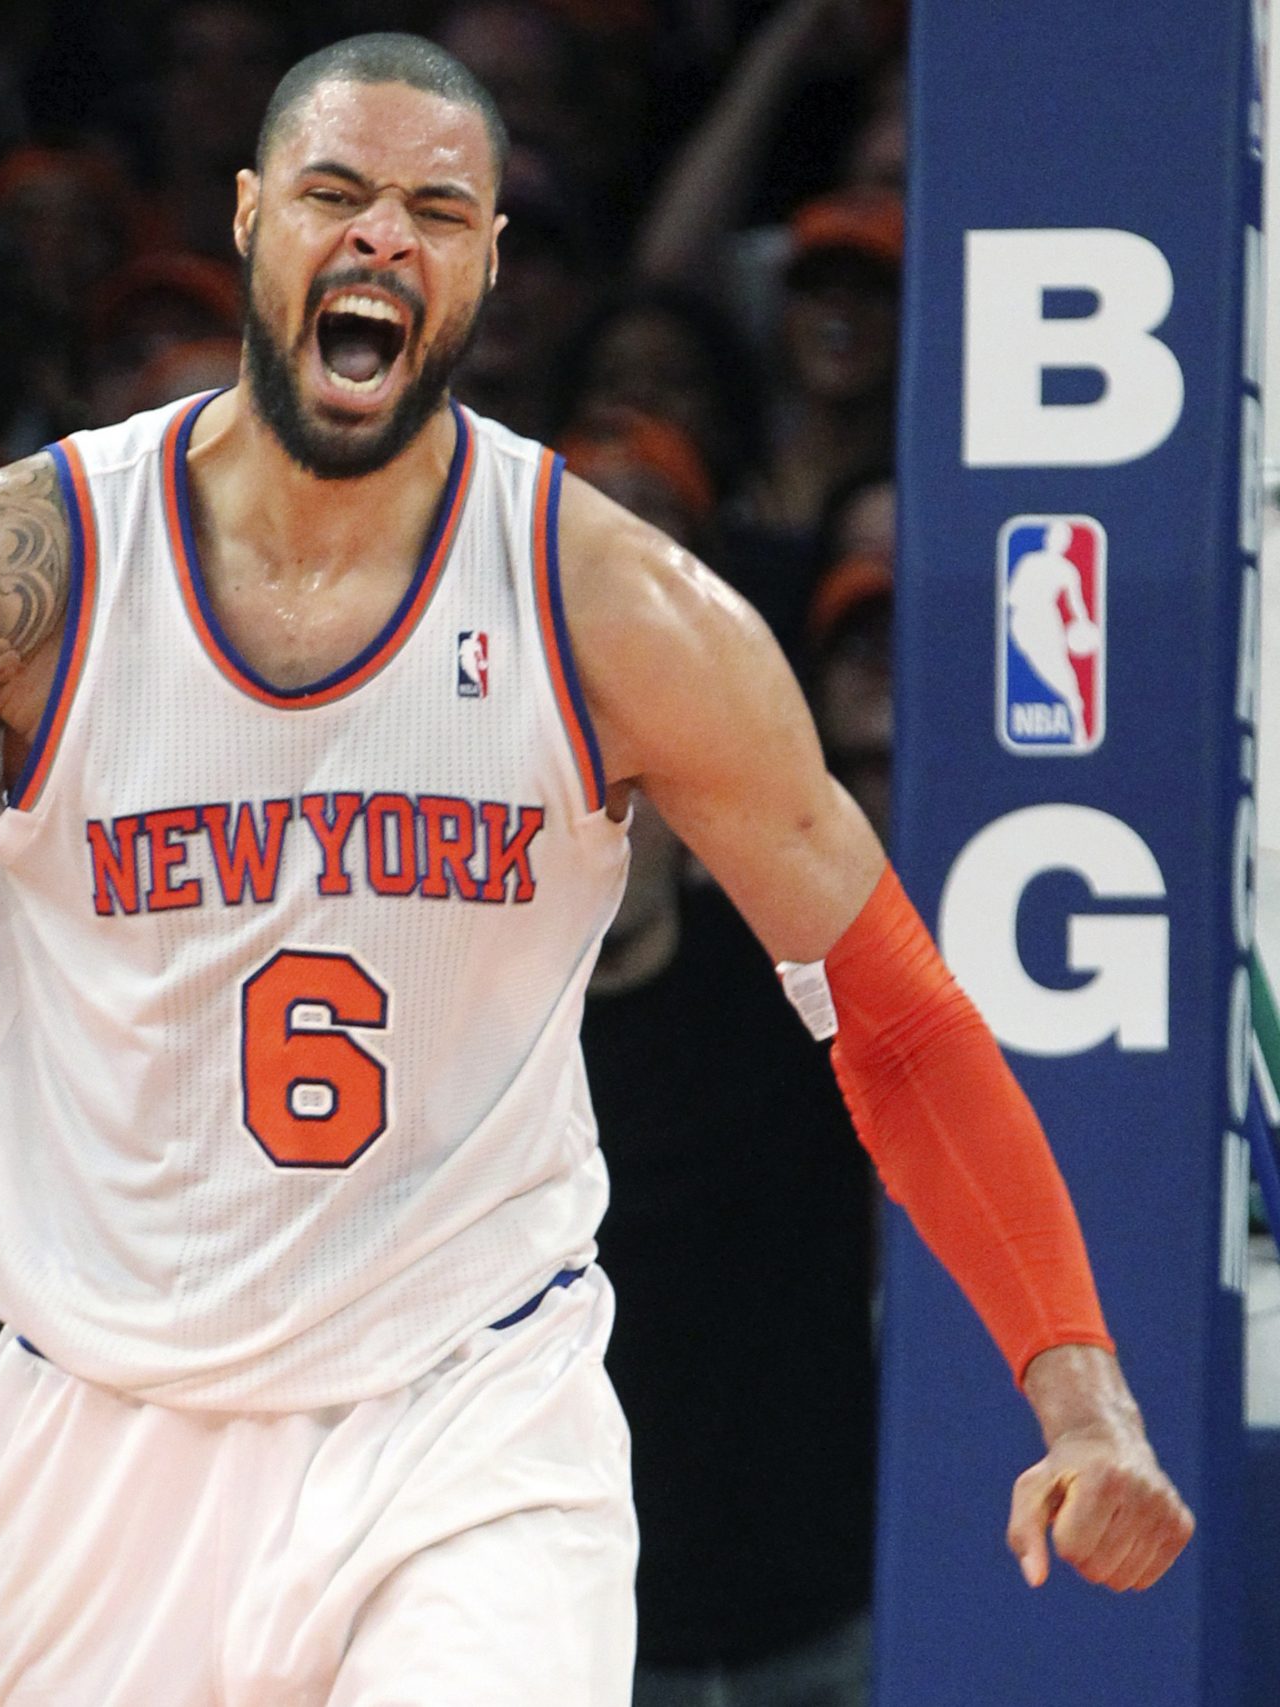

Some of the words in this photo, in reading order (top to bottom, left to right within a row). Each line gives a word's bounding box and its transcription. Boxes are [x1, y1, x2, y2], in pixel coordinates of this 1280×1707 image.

[963, 227, 1185, 469] B
[1011, 702, 1071, 737] NBA
[86, 798, 292, 916] NEW
[301, 792, 545, 904] YORK
[938, 803, 1170, 1058] G
[241, 948, 388, 1168] 6
